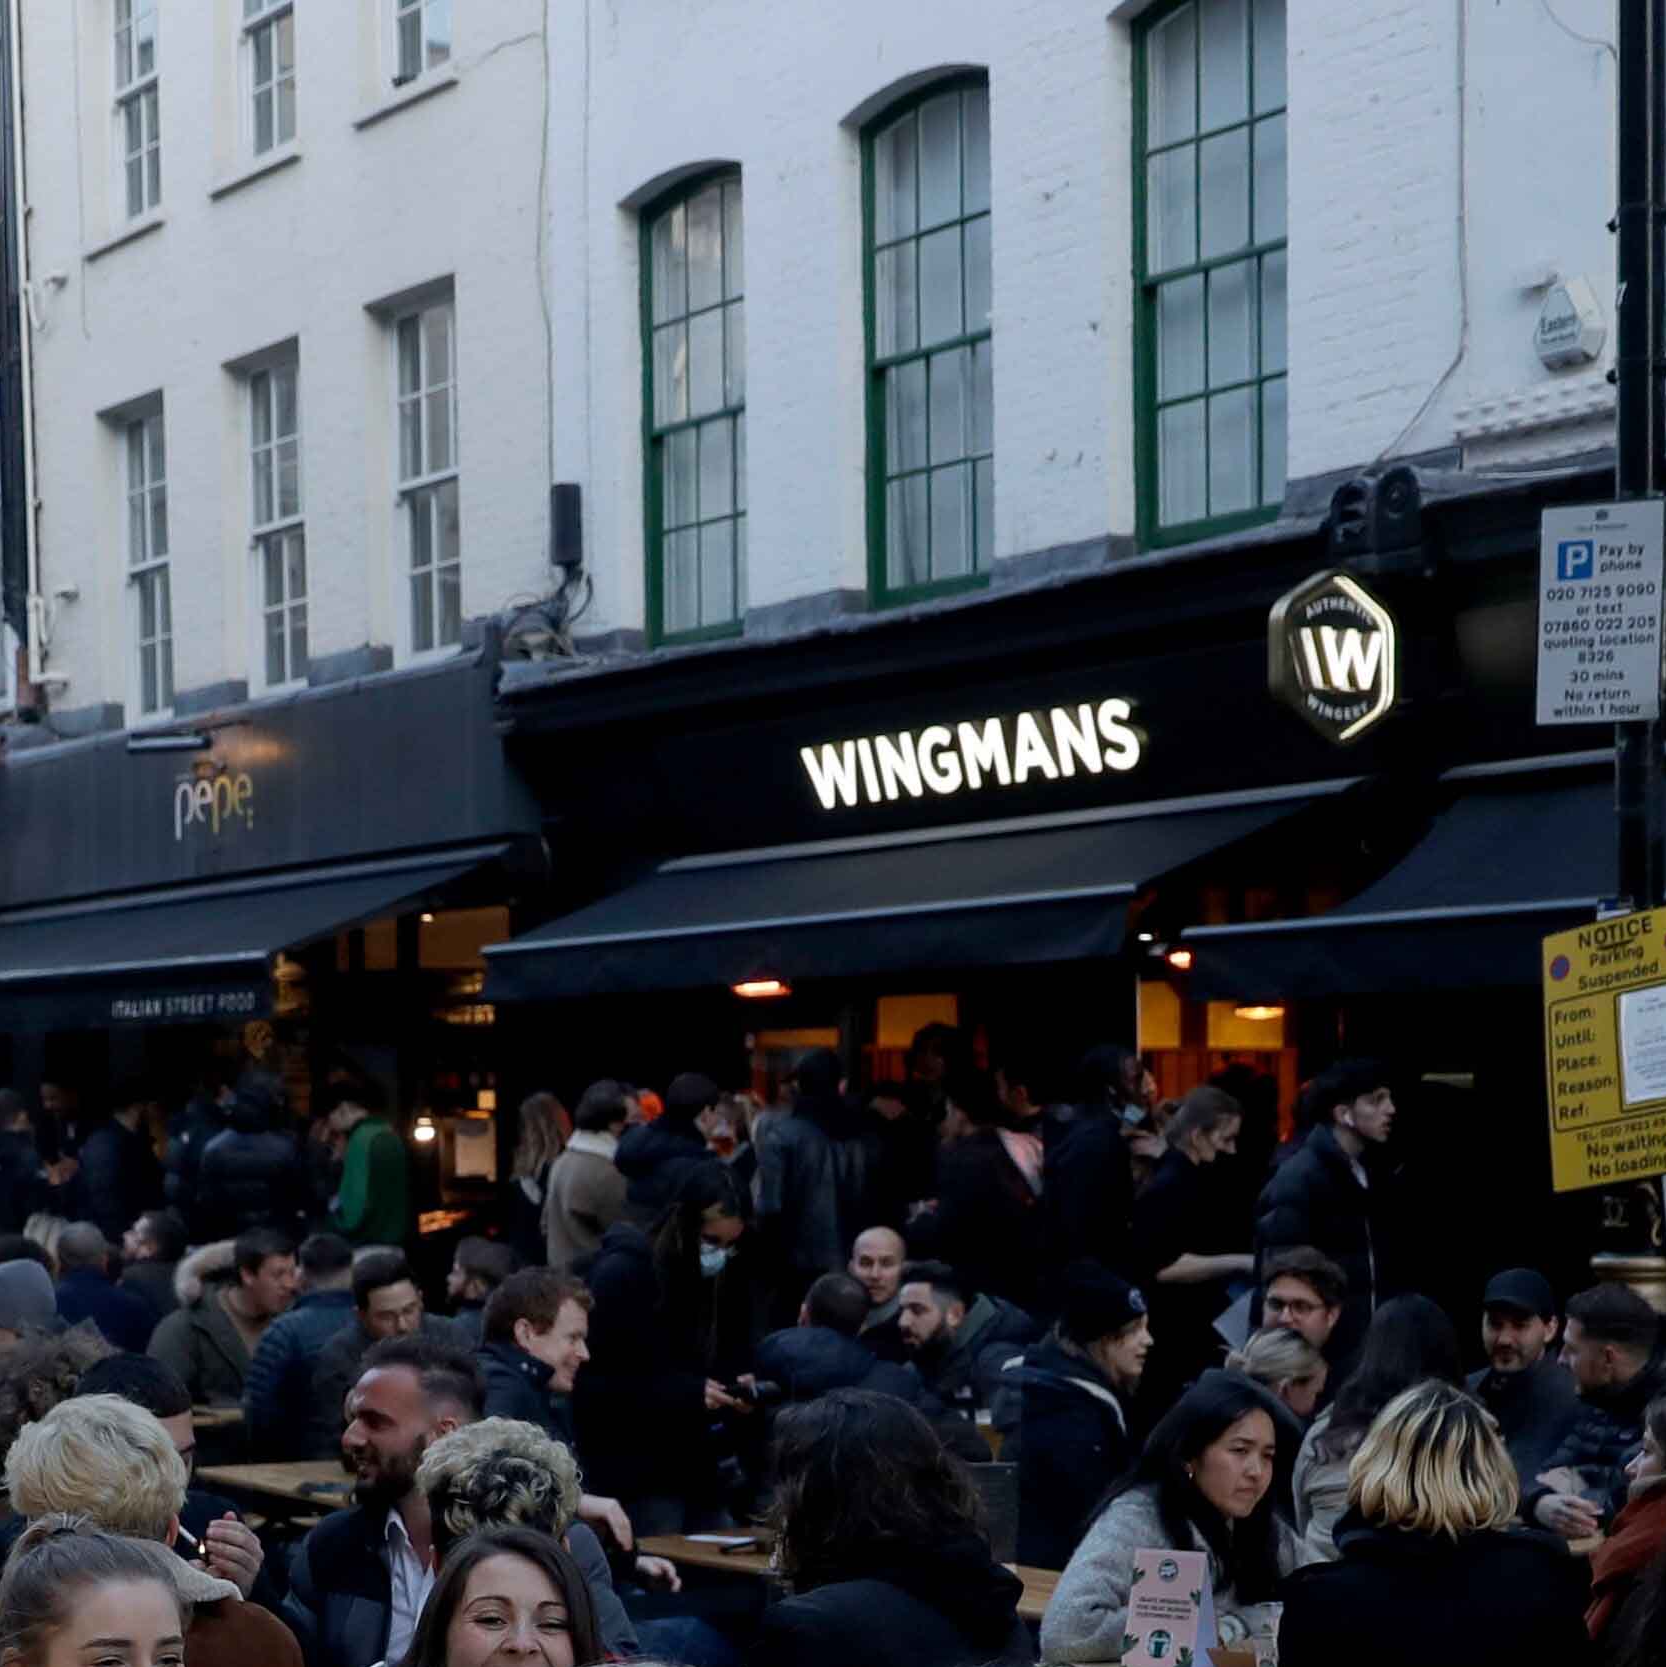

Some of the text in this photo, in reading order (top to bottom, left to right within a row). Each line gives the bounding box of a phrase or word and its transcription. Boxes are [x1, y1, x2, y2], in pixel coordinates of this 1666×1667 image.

[1565, 541, 1645, 577] P Pay by
[1600, 559, 1642, 573] phone
[1547, 582, 1655, 600] 020 7125 9090
[1576, 602, 1622, 616] or text
[1596, 617, 1622, 631] 022
[1628, 615, 1656, 629] 205
[1543, 632, 1654, 651] quoting location
[1571, 668, 1624, 683] 30 mins
[1564, 688, 1631, 701] No return
[1554, 703, 1594, 718] within
[1609, 702, 1640, 714] hour
[799, 698, 1142, 811] WINGMANS
[1578, 915, 1653, 949] NOTICE
[1589, 944, 1644, 968] Parking
[1579, 959, 1659, 990] Suspended
[111, 990, 256, 1020] ITALIAN STREET FOOD
[1554, 1007, 1595, 1025] From:
[1555, 1028, 1596, 1048] Until:
[1557, 1055, 1602, 1072] Place:
[1557, 1075, 1616, 1096] Reason:
[1559, 1104, 1590, 1120] Ref:
[1586, 1142, 1609, 1159] No
[1588, 1162, 1611, 1179] No
